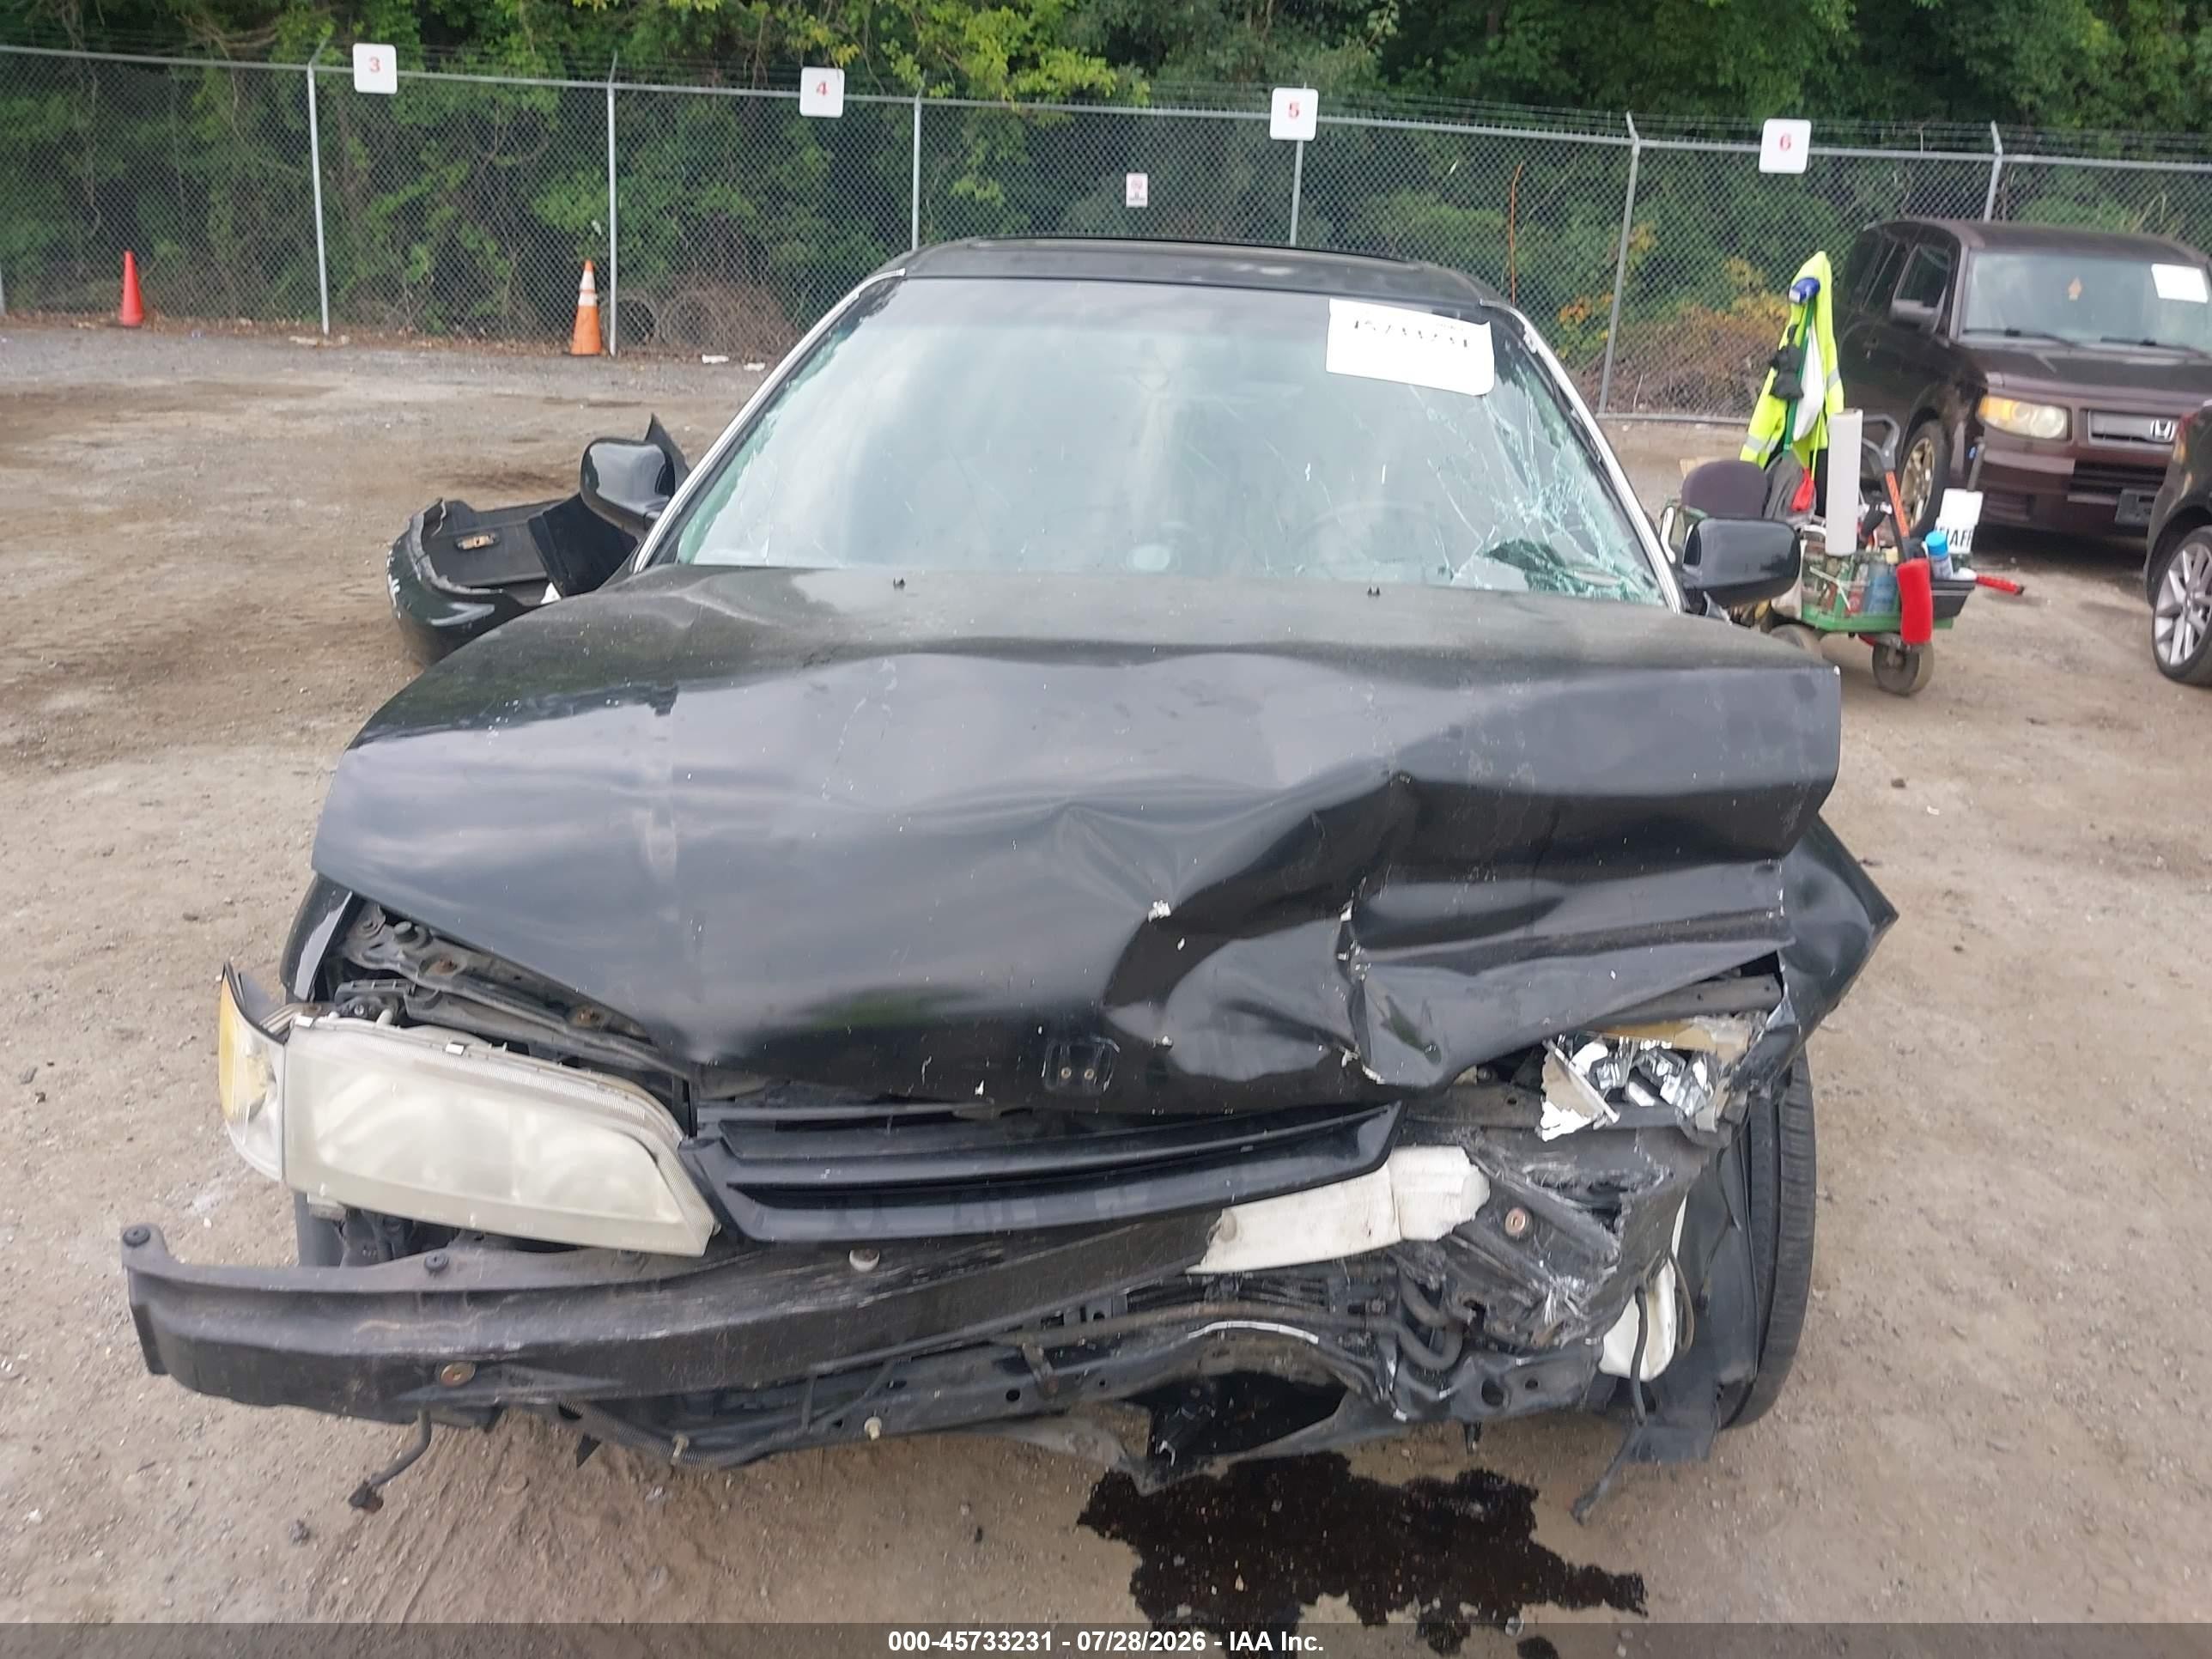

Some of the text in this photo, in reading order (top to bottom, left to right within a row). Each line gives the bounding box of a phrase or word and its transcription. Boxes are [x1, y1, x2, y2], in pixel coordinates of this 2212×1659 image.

[368, 56, 380, 72] 3
[816, 81, 829, 96] 4
[1289, 101, 1300, 119] 5
[1779, 133, 1792, 151] 6
